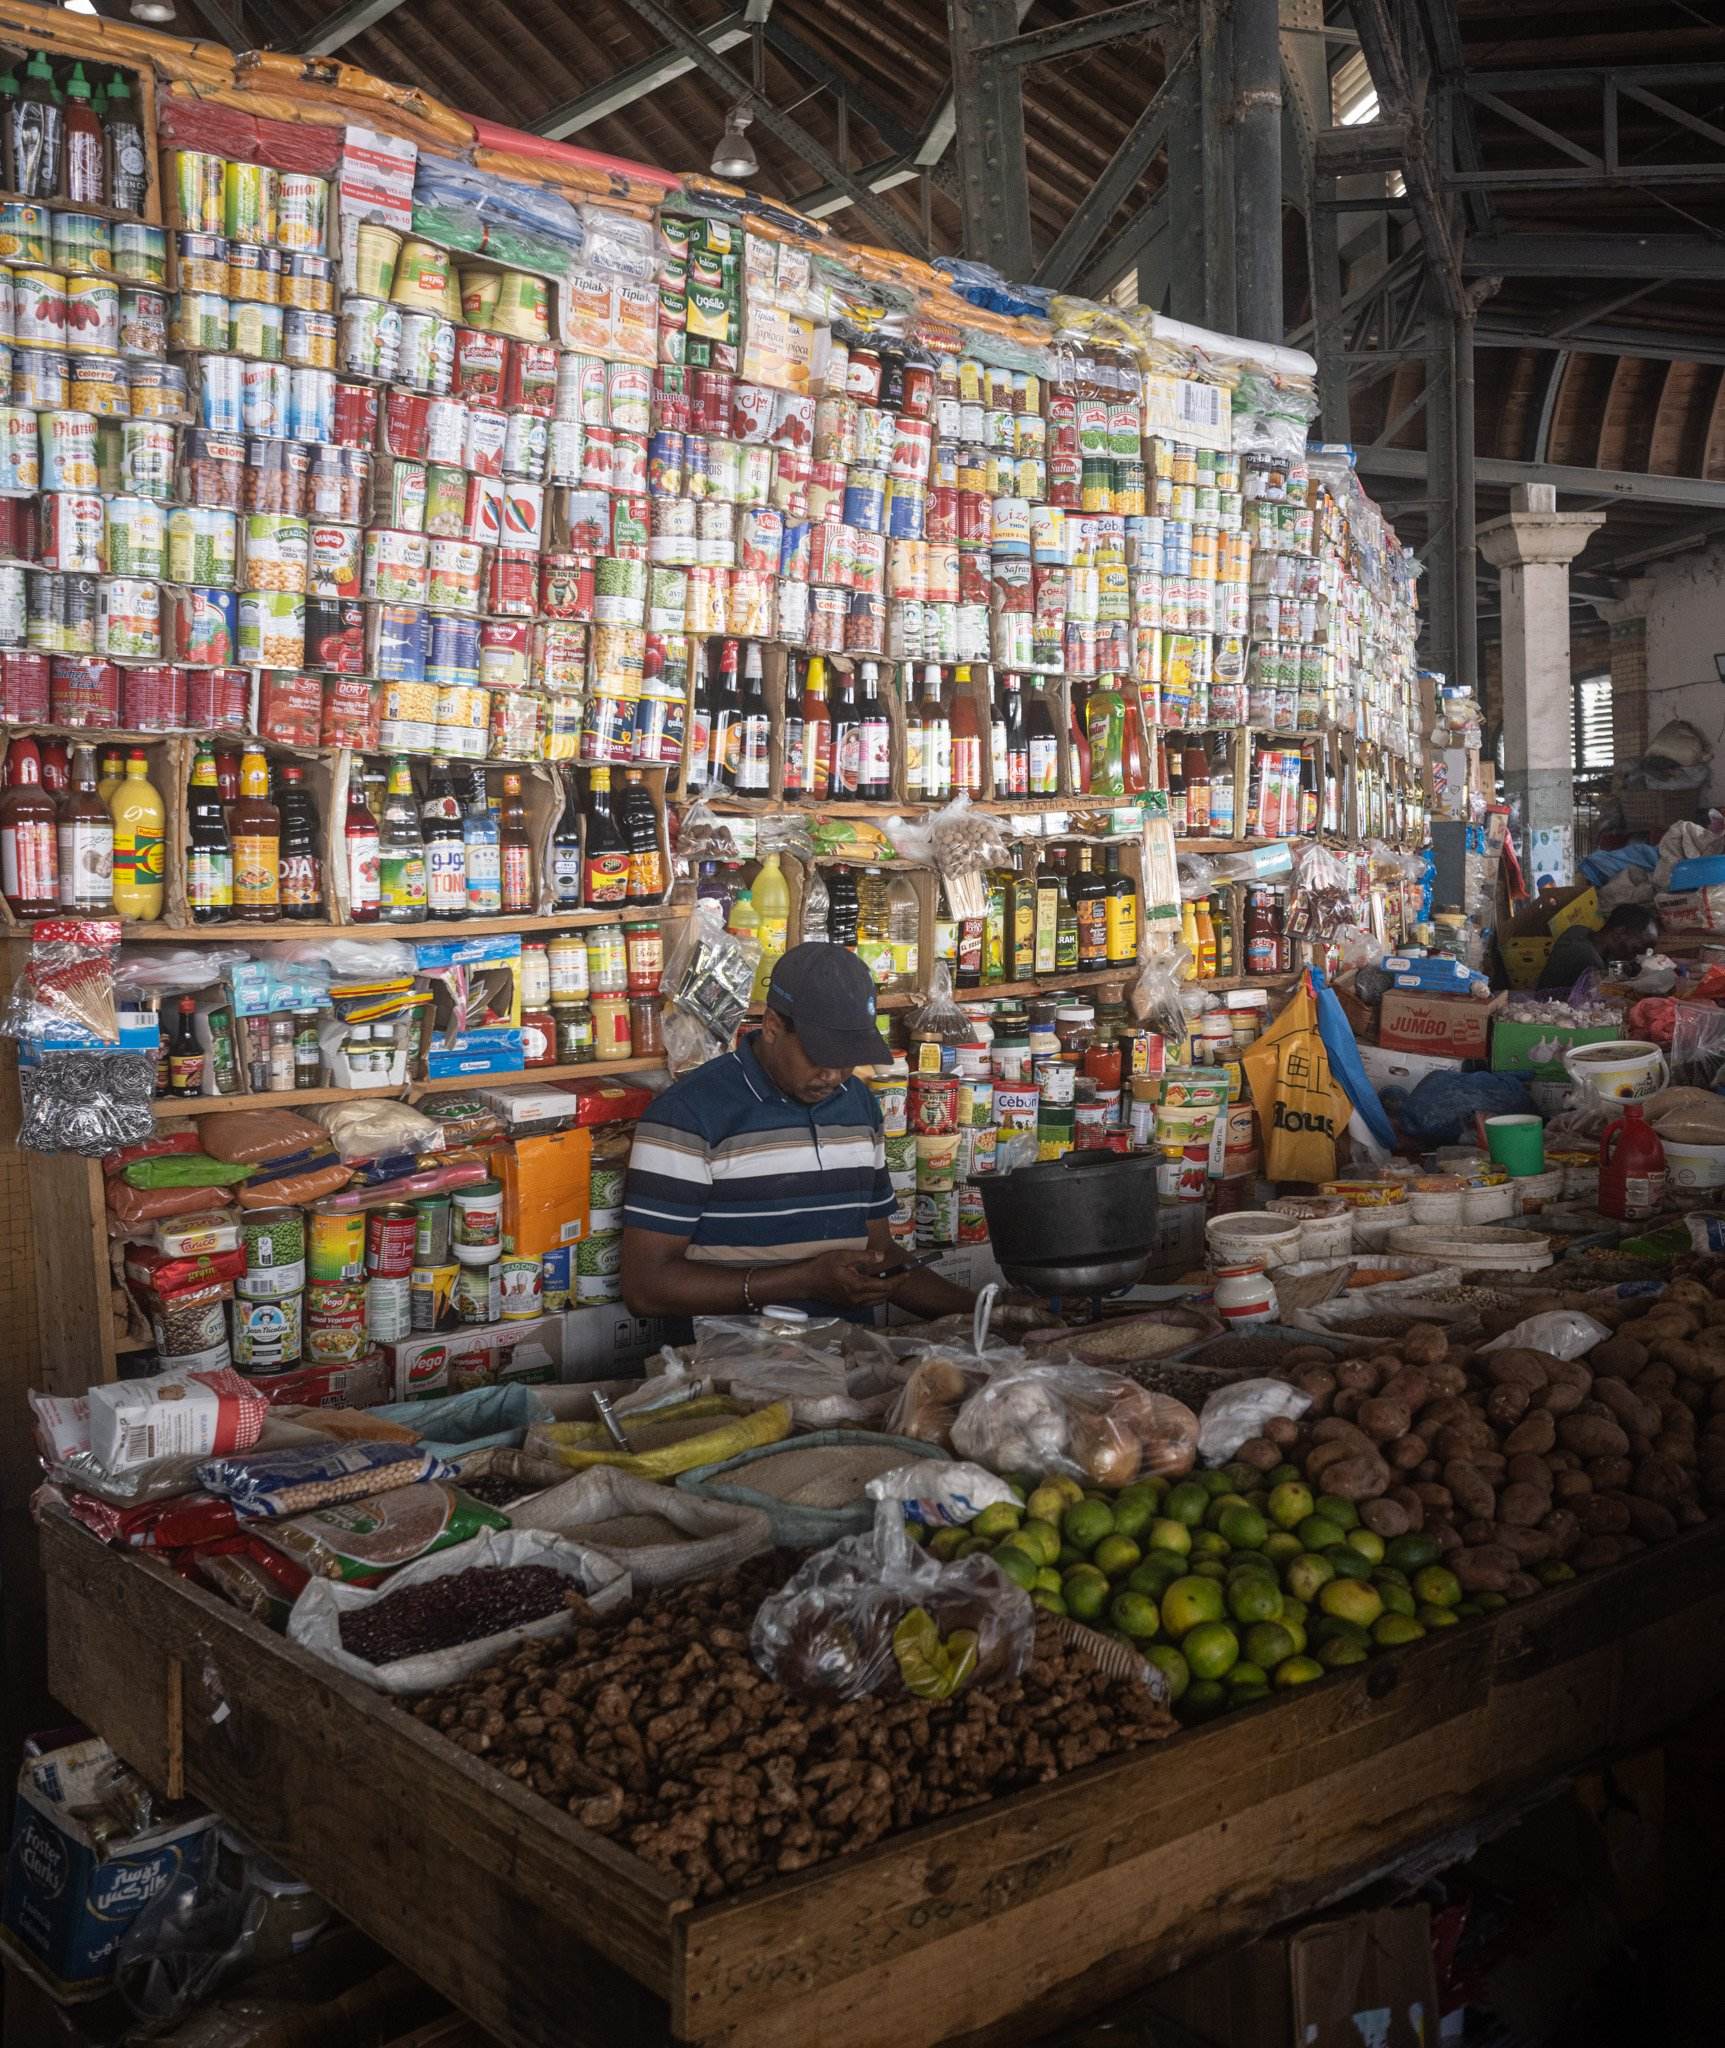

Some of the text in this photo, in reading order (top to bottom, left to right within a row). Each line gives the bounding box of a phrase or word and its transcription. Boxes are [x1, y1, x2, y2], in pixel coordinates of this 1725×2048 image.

[574, 276, 604, 294] Tipiak
[622, 287, 651, 304] Tipiak
[280, 858, 313, 879] OJA
[1390, 1016, 1448, 1037] JUMBO
[412, 1354, 445, 1371] Vega
